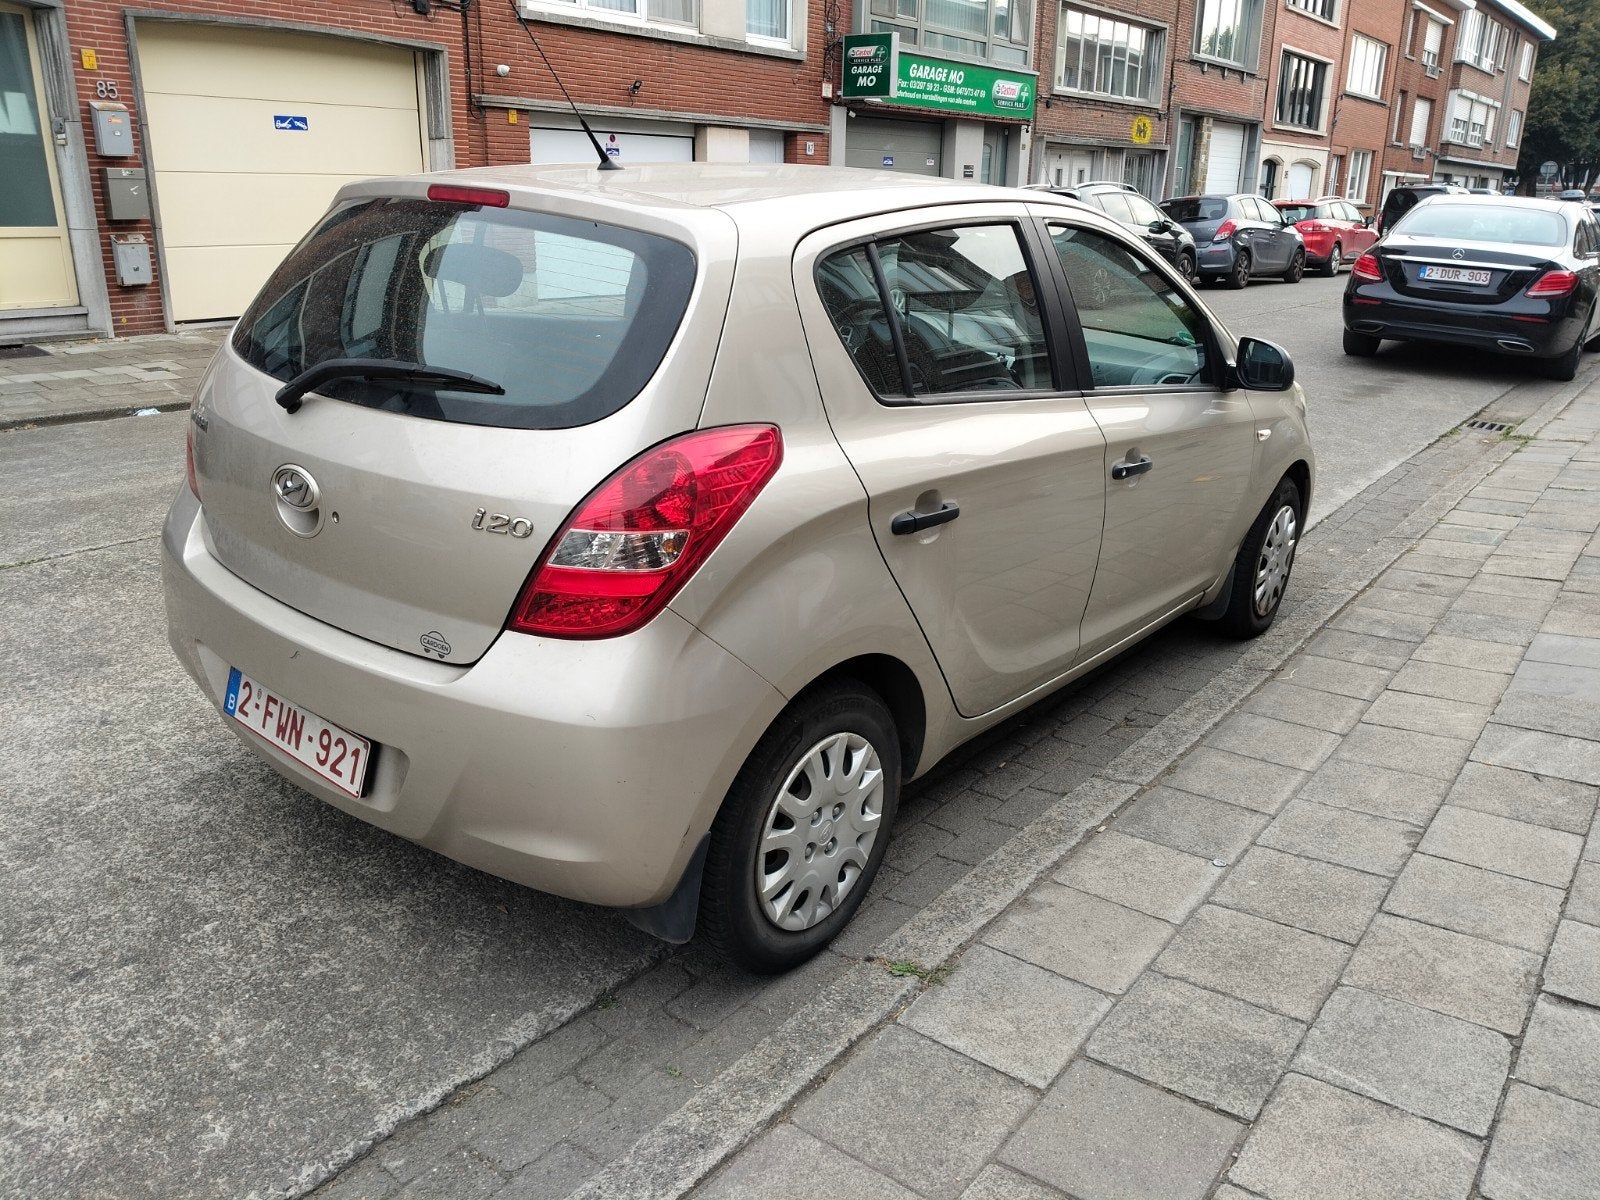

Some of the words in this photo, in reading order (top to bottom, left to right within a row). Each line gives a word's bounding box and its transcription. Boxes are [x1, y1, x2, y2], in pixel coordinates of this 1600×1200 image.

[851, 65, 883, 74] GARAGE
[910, 64, 948, 81] GARAGE
[949, 70, 964, 84] MO
[856, 75, 877, 87] MO
[96, 80, 118, 98] 85
[943, 84, 956, 94] GSM:
[1000, 85, 1017, 96] Castrol
[997, 99, 1013, 107] SERVICE
[471, 507, 534, 539] i20
[422, 637, 449, 653] CARDOEN
[227, 693, 236, 710] B
